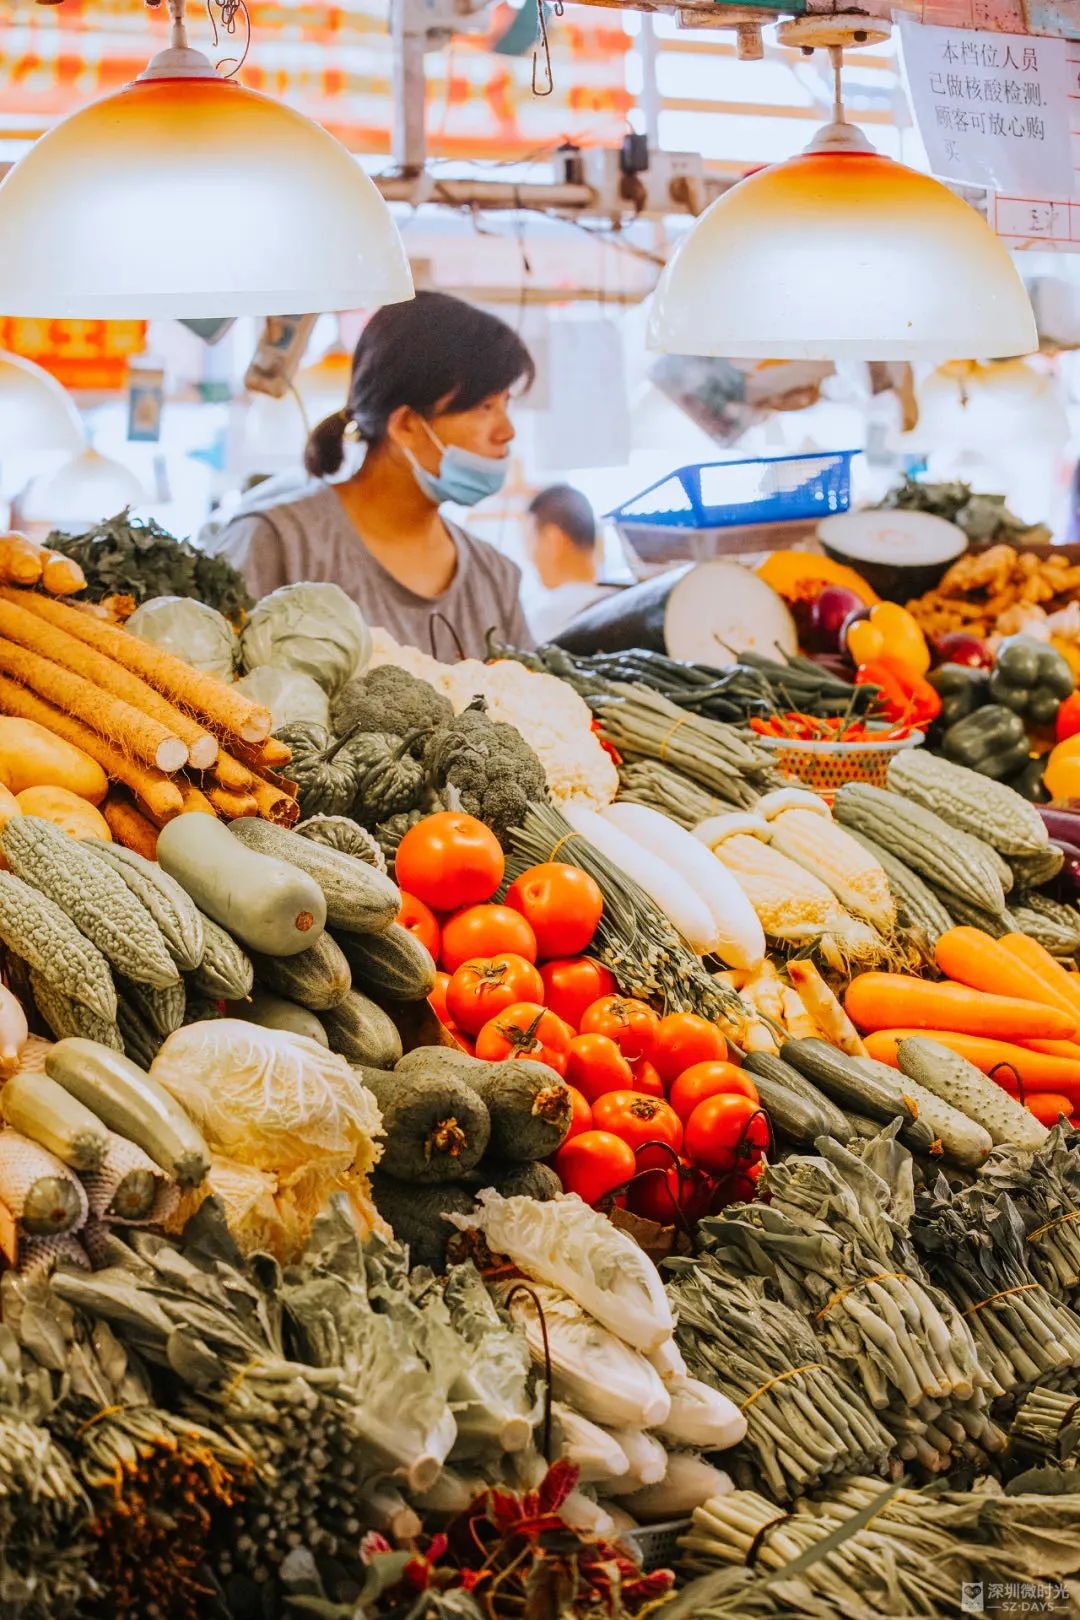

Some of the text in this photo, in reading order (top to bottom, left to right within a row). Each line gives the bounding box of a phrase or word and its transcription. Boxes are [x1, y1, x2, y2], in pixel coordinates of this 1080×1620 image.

[942, 40, 1038, 72] 本档位人员
[936, 106, 1044, 140] 顾客可放心购
